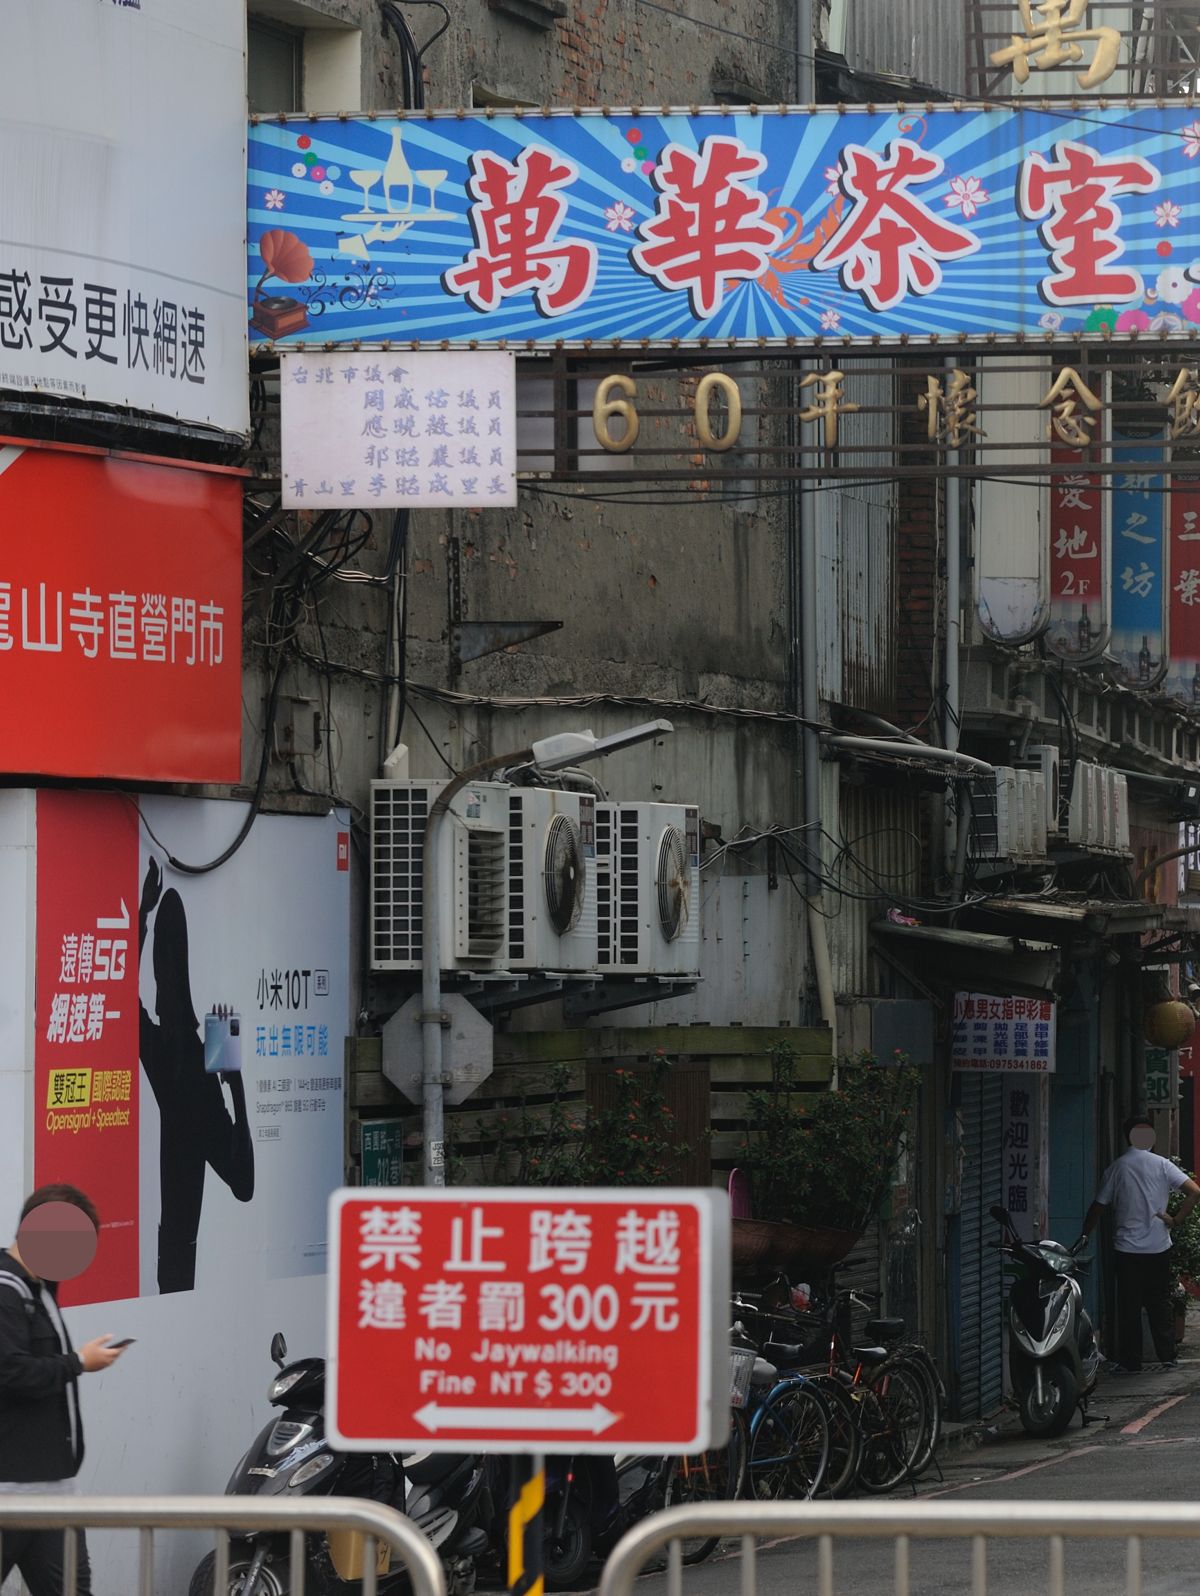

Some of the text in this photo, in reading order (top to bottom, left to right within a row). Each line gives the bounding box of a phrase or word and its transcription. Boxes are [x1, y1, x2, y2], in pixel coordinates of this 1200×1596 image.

[0, 269, 206, 385] 感受更快網速
[291, 364, 409, 384] 台北市議會
[1053, 460, 1098, 595] 愛地 2F
[46, 993, 121, 1044] 網速第一
[52, 1072, 87, 1105] 雙冠王
[46, 1111, 92, 1136] Opensignal
[96, 1107, 131, 1132] Speedtest
[1008, 1089, 1029, 1212] 歡迎光臨
[358, 1206, 681, 1275] 禁止跨越
[415, 1337, 619, 1371] No Jaywalking
[419, 1370, 476, 1395] Fine
[560, 1371, 612, 1397] 300
